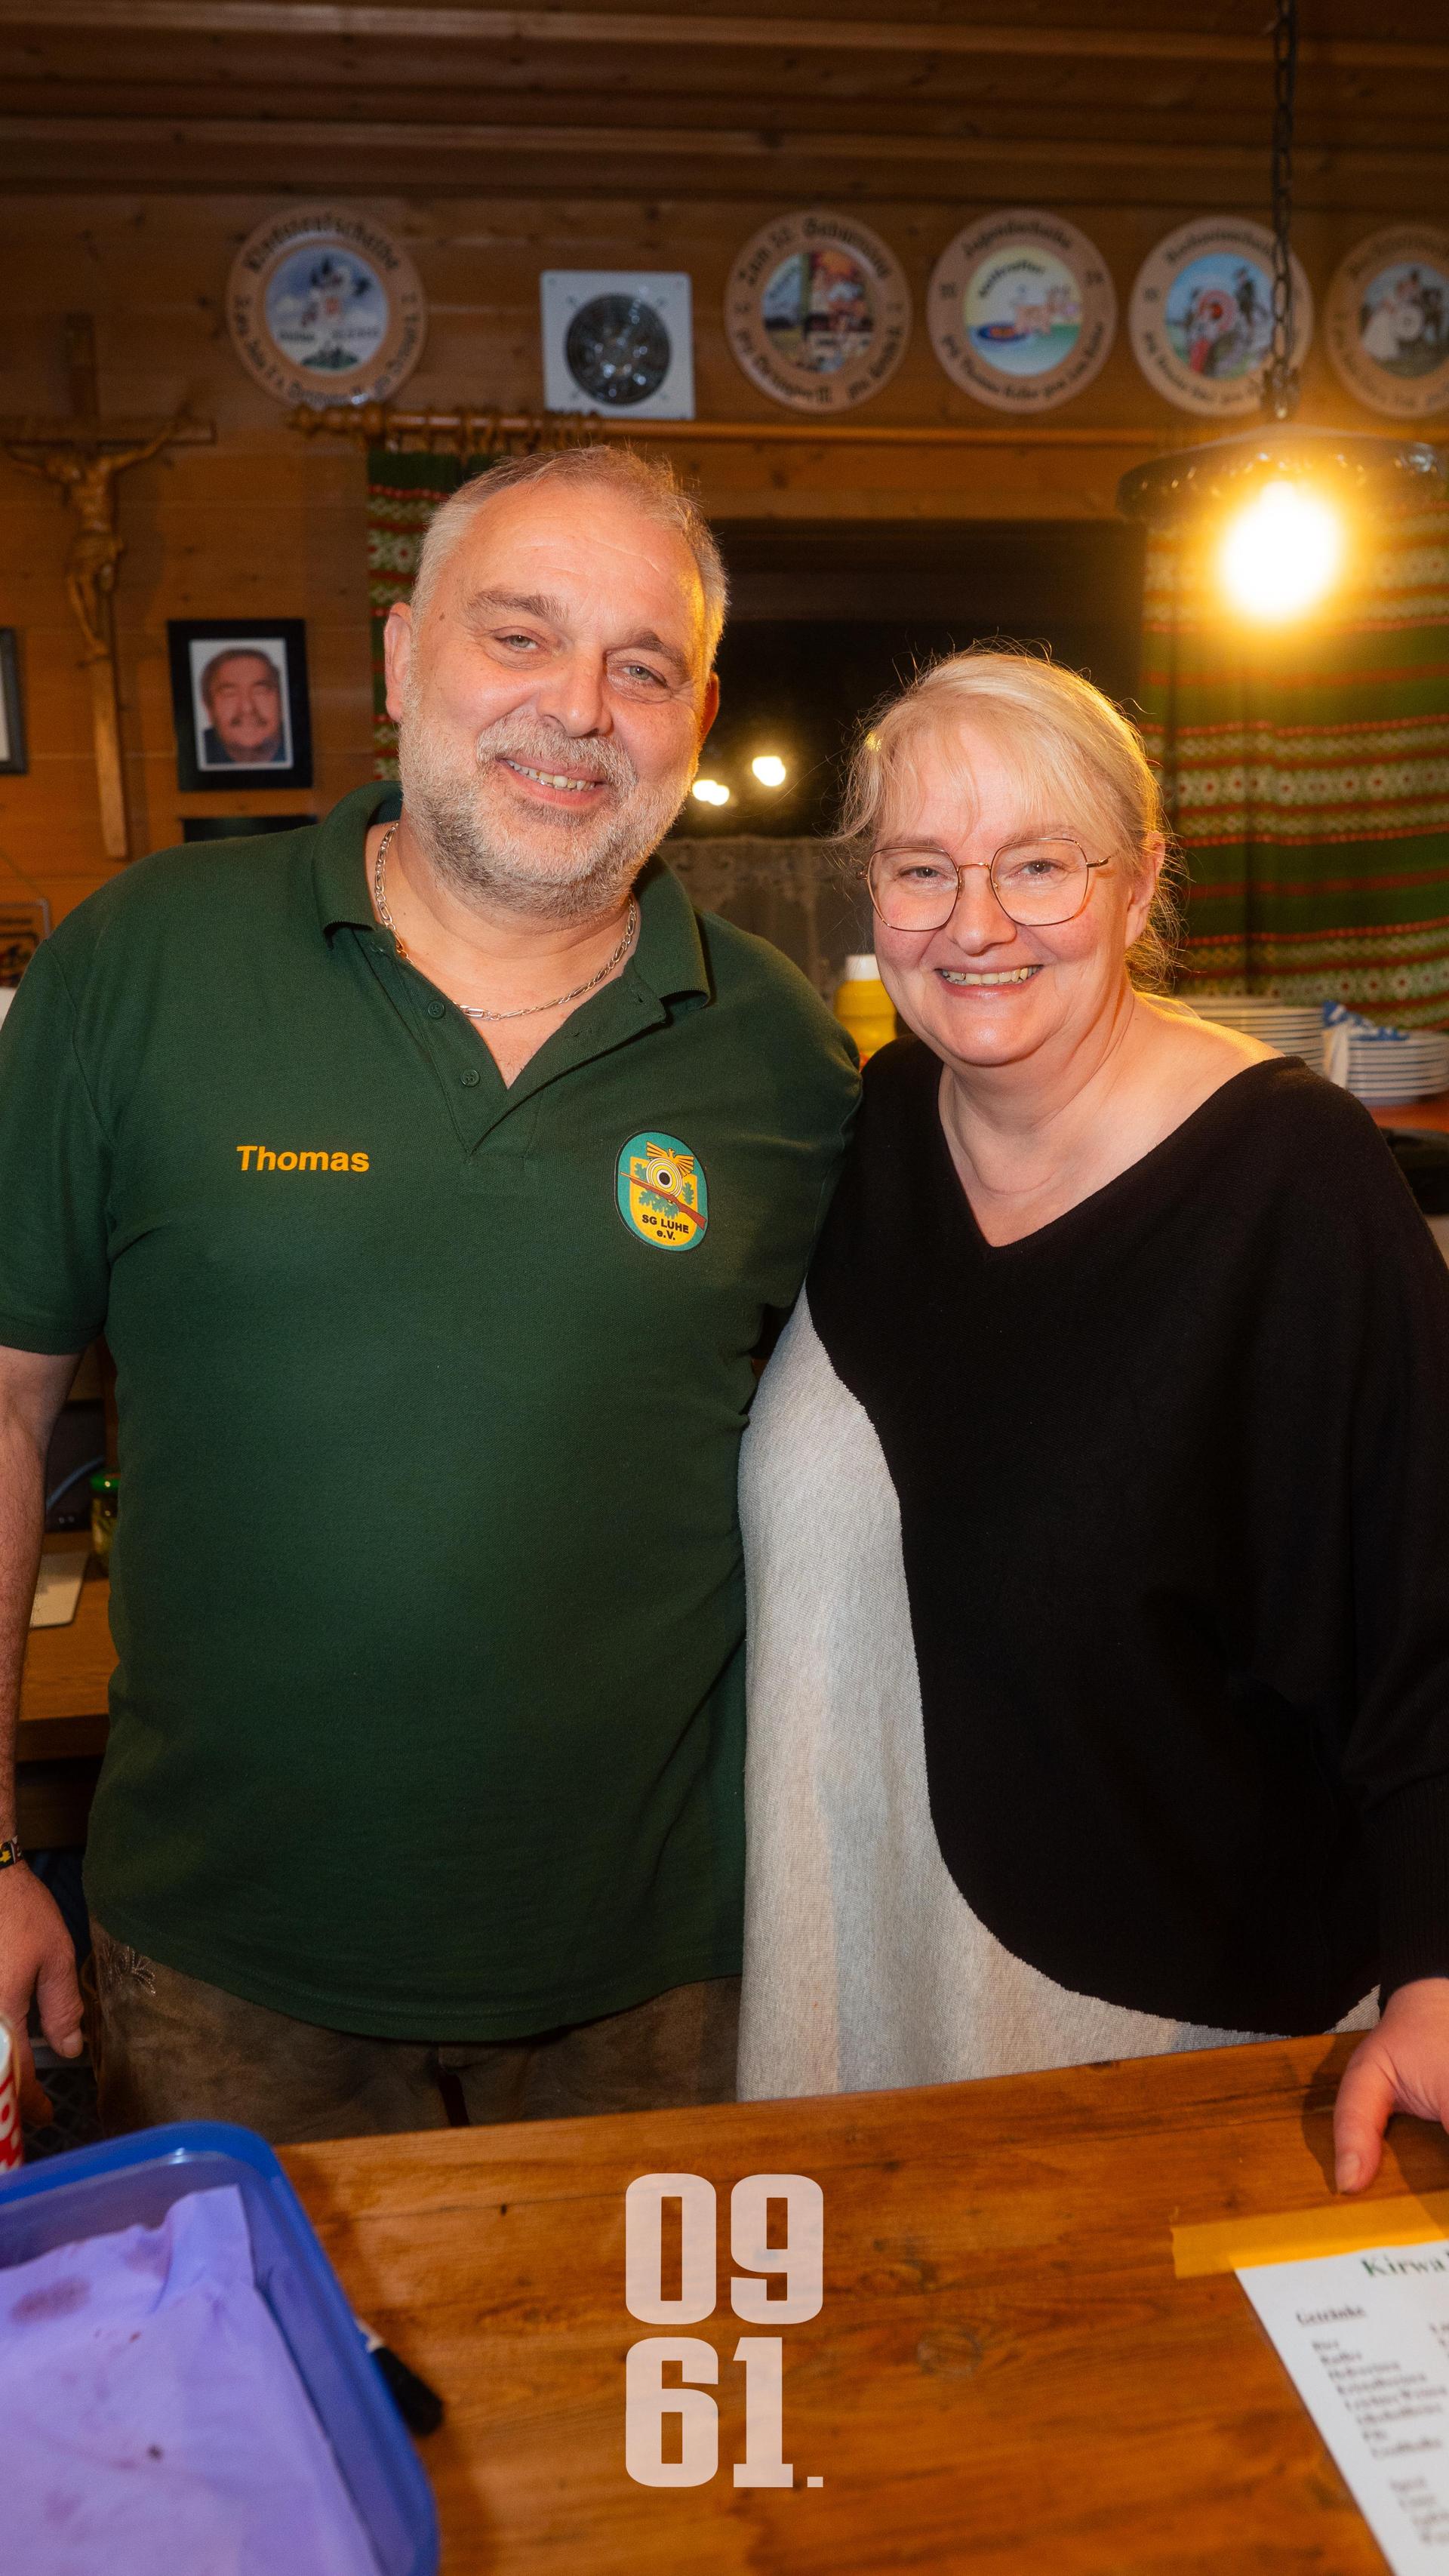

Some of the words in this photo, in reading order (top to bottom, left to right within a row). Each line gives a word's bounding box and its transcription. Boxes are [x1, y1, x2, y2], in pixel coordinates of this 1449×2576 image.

[236, 1144, 370, 1172] Thomas
[641, 1214, 657, 1225] SG
[660, 1218, 690, 1234] LUHE
[656, 1229, 675, 1240] e.V.
[1361, 2252, 1446, 2277] Kirwa
